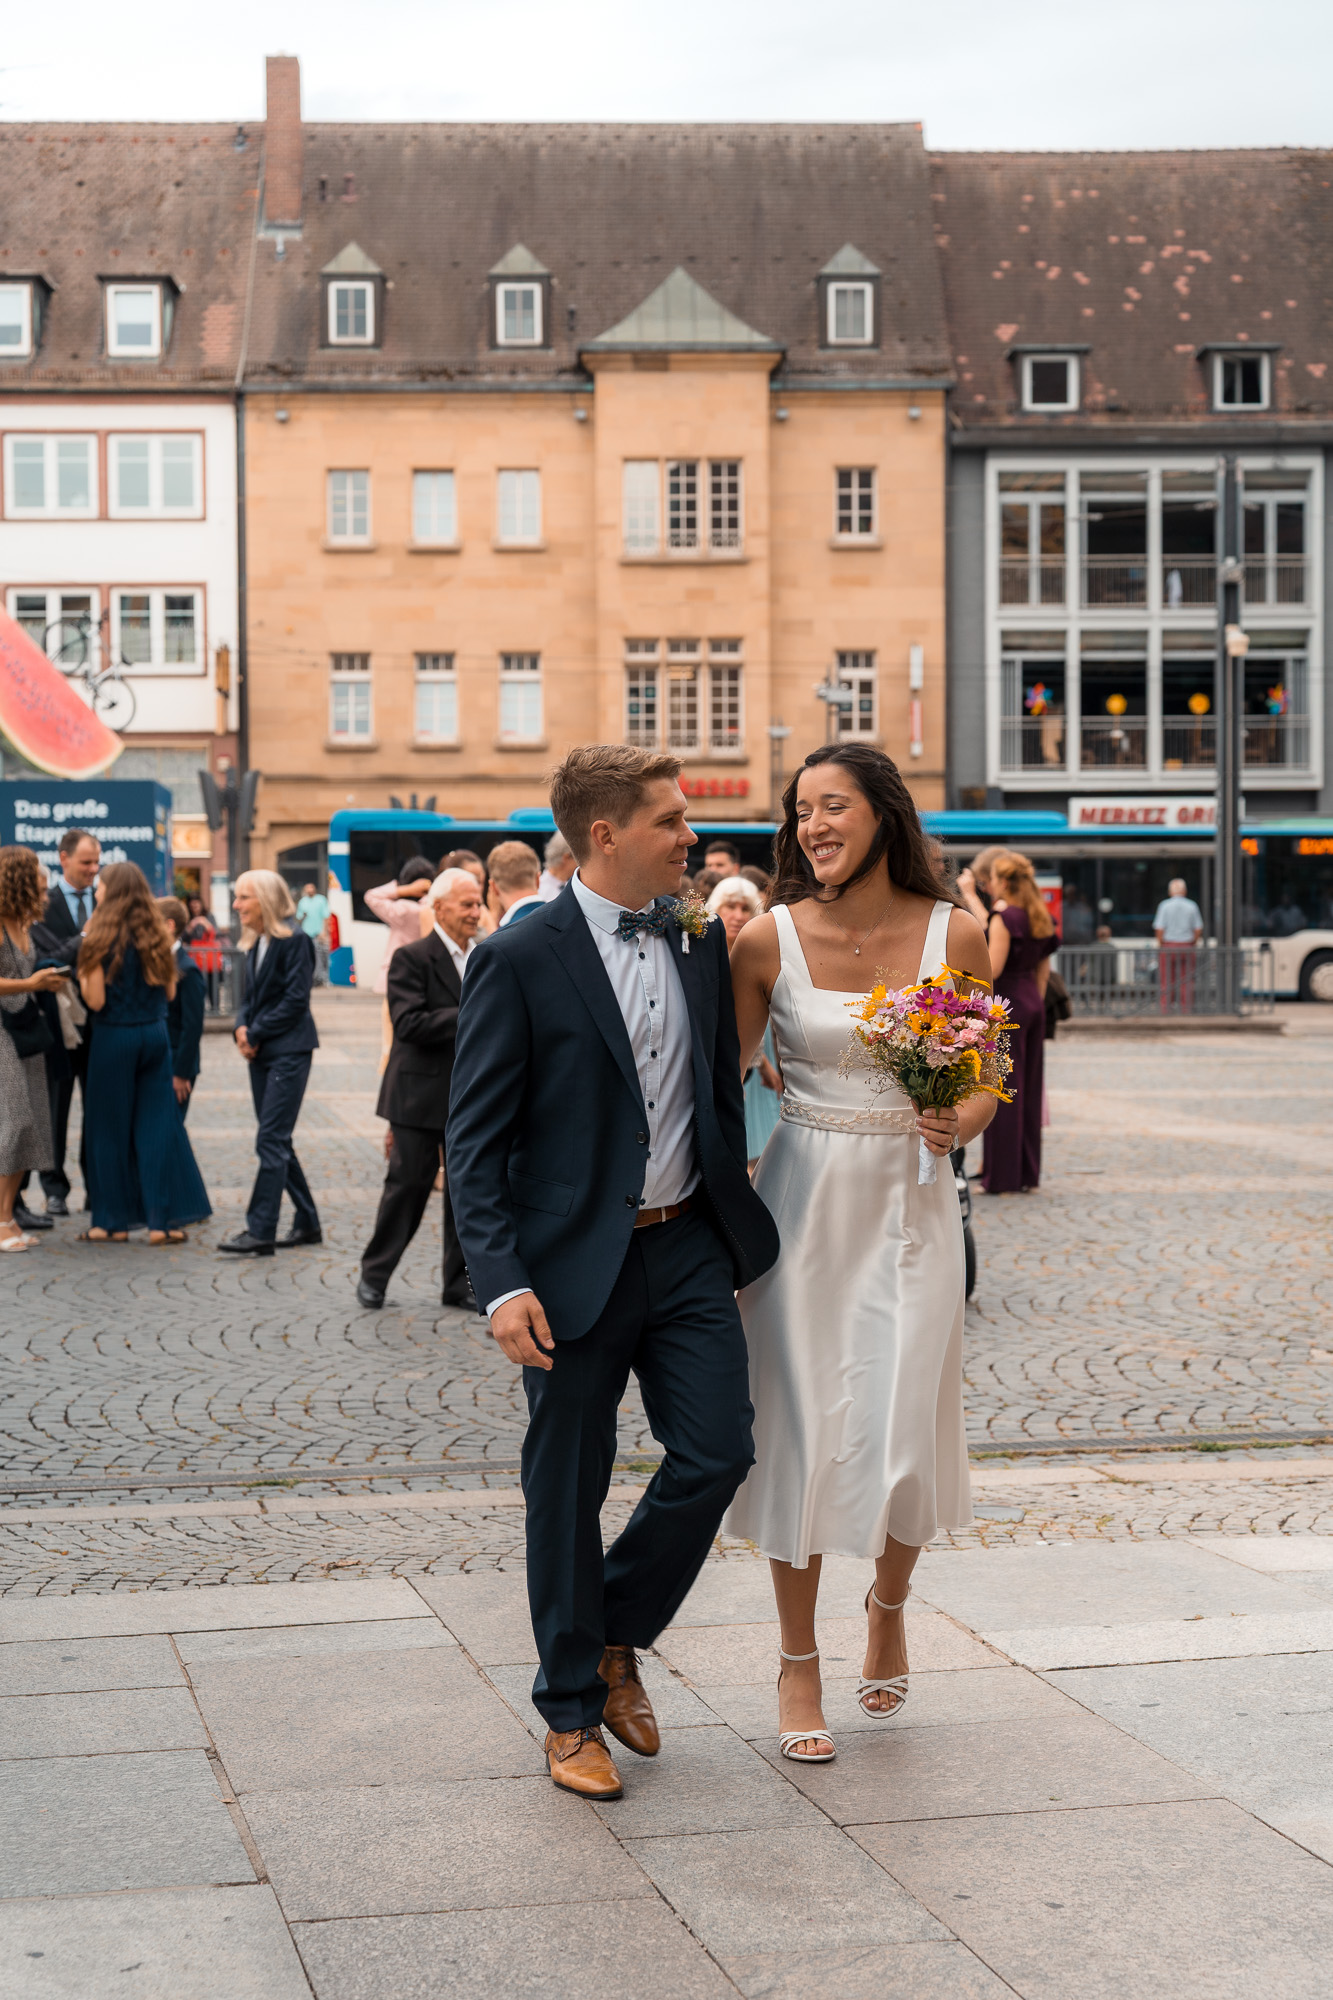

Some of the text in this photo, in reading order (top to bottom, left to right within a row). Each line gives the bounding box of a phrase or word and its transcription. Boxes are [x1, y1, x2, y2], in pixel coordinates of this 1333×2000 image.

[677, 773, 751, 796] kasse
[14, 799, 109, 823] Das große
[1079, 806, 1216, 825] MERKEZ GRI
